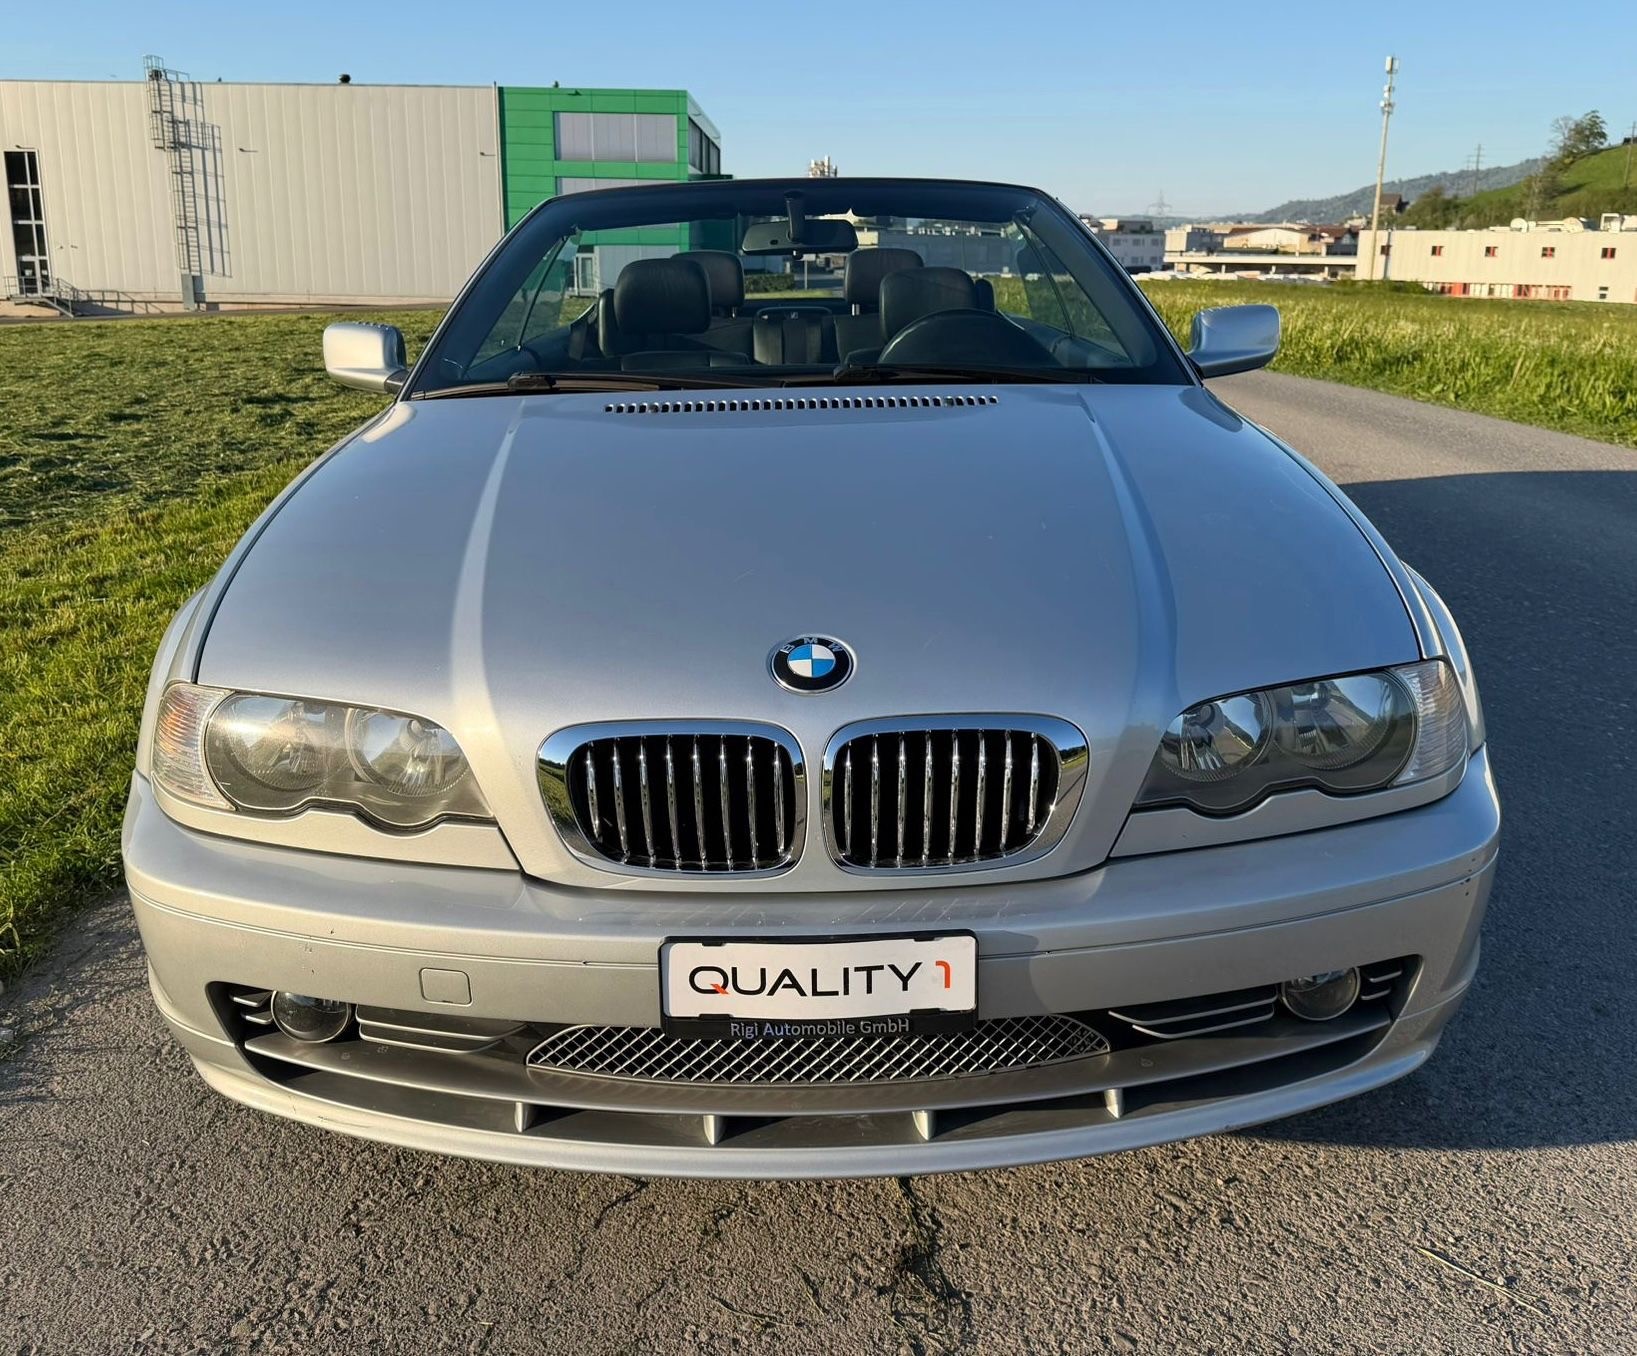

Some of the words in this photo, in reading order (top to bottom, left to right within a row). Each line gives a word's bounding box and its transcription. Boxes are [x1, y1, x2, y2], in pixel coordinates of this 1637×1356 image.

[780, 637, 843, 654] BMW
[688, 961, 923, 996] QUALITY
[935, 960, 951, 989] 1
[730, 1021, 759, 1039] Rigi
[763, 1020, 855, 1037] Automobile
[859, 1018, 910, 1034] GmbH
